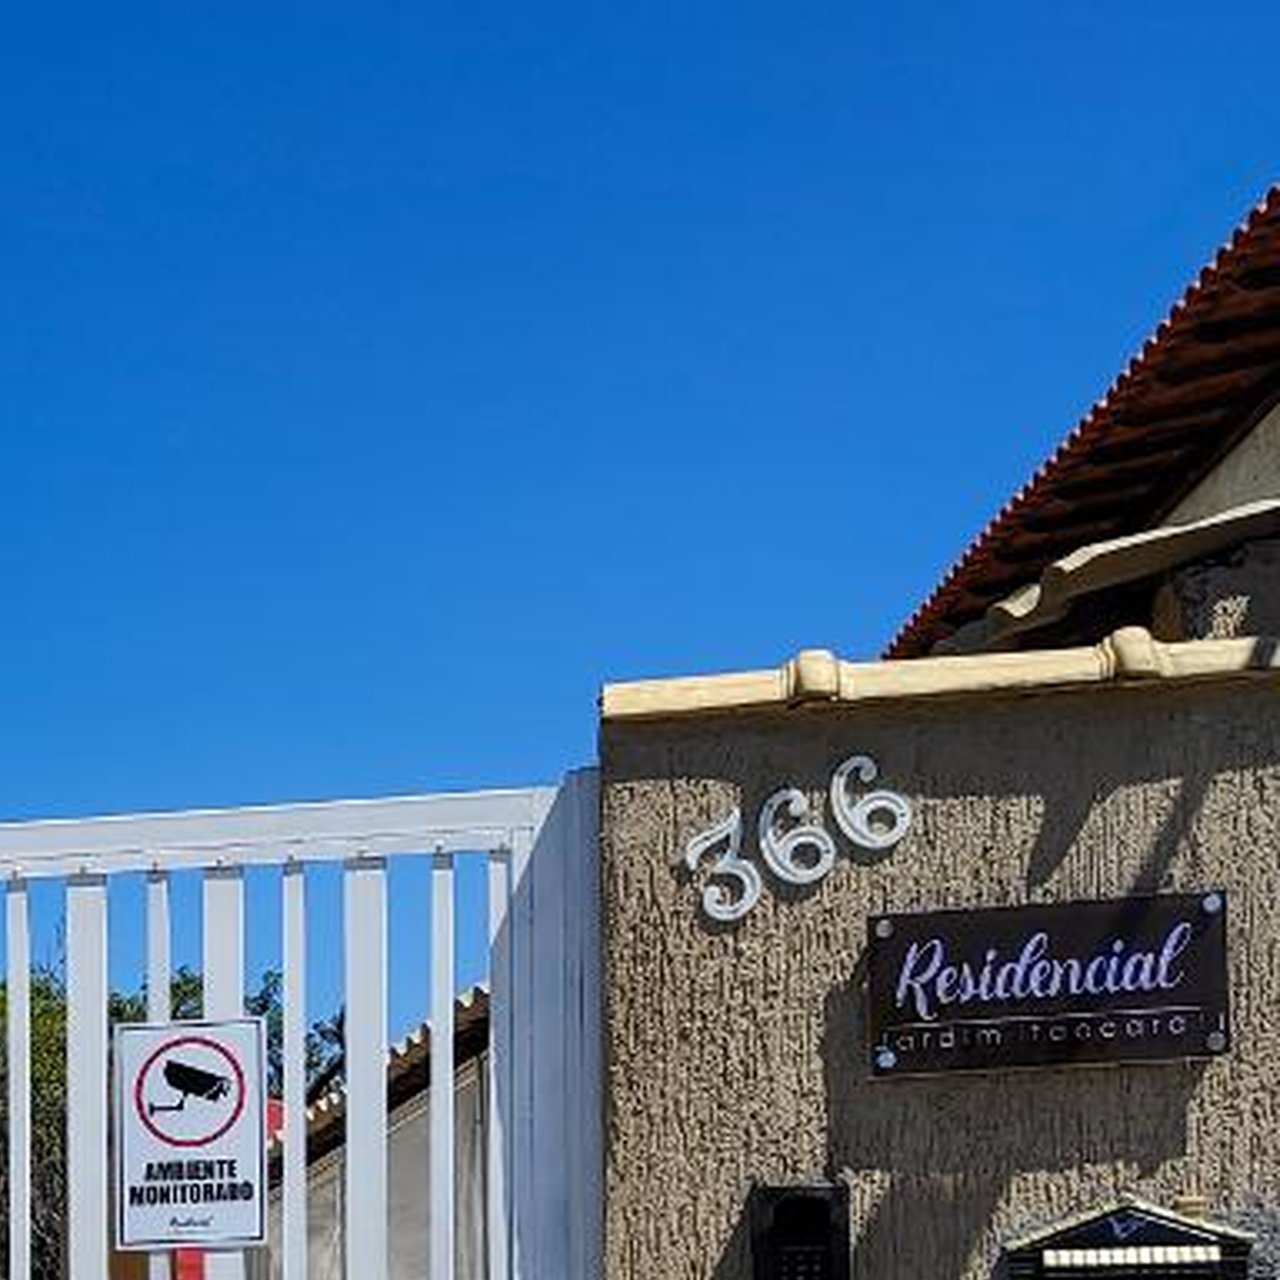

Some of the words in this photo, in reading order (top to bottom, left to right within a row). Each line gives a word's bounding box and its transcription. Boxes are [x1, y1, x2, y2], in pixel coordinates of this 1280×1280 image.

[686, 754, 912, 922] 366
[895, 922, 1193, 1020] Residencial
[128, 1181, 255, 1207] MONITORADO
[143, 1159, 238, 1183] AMBIENTE
